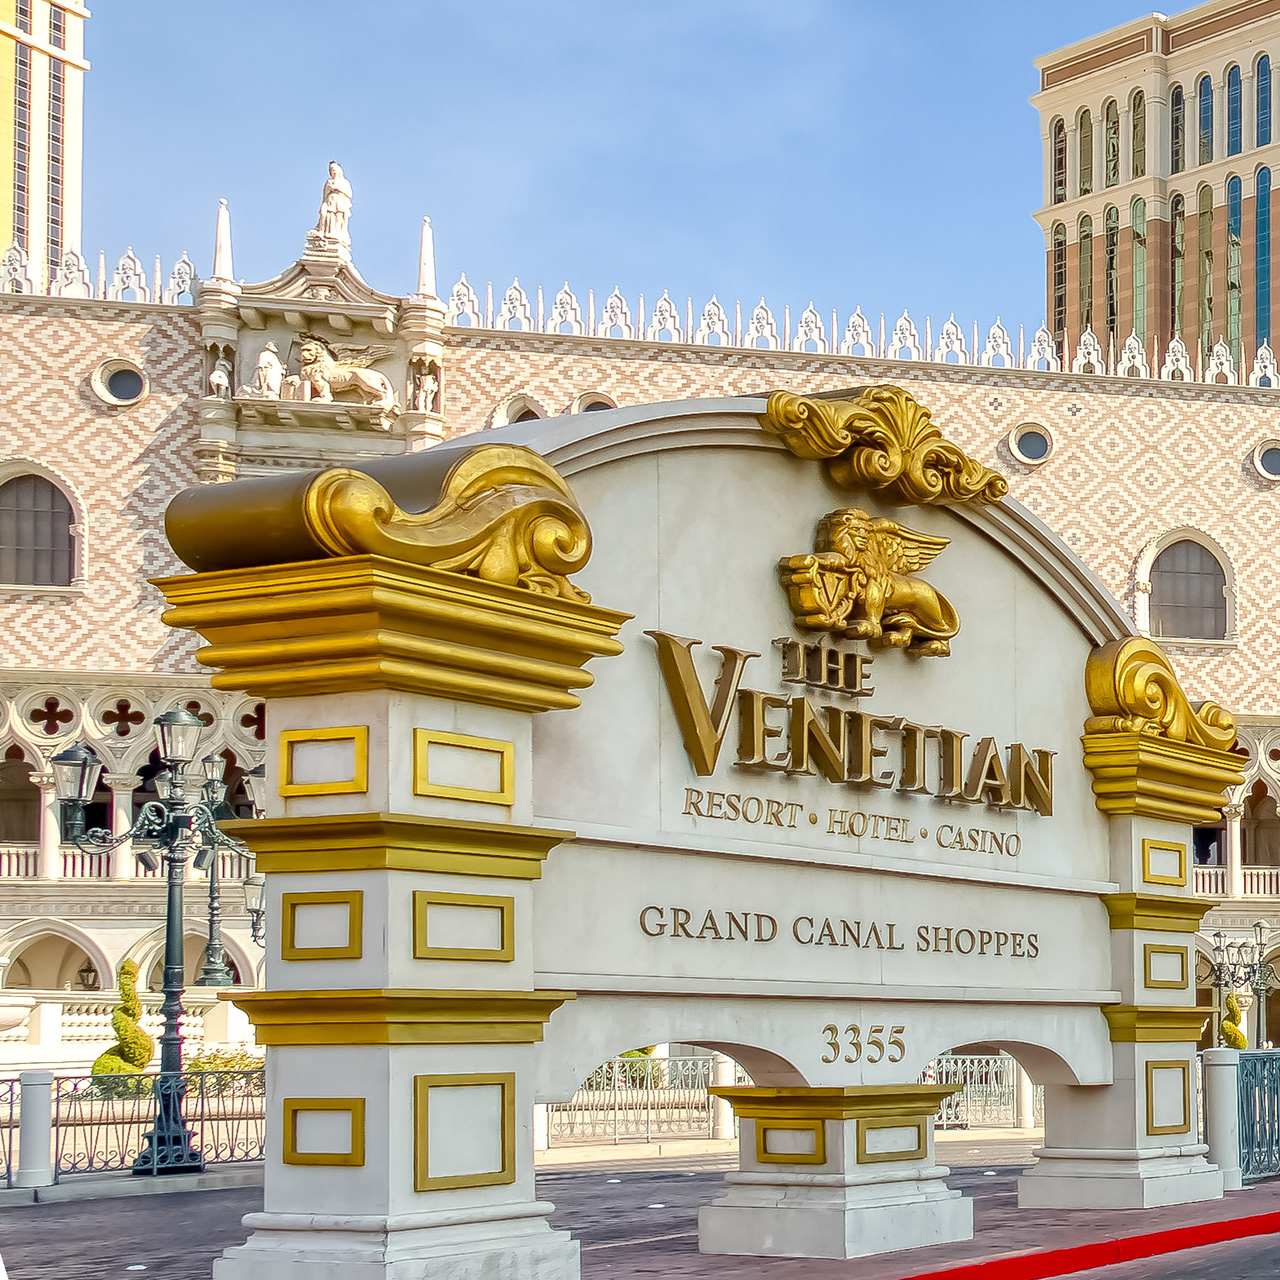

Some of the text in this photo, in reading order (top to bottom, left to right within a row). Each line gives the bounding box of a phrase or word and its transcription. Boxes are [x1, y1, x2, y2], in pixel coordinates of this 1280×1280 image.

[771, 635, 875, 698] THE
[643, 629, 1059, 817] VENETIAN
[682, 787, 1022, 857] RESORT HOTEL CASINO
[639, 905, 1040, 959] GRAND CANAL SHOPPES
[820, 1023, 906, 1064] 3355
